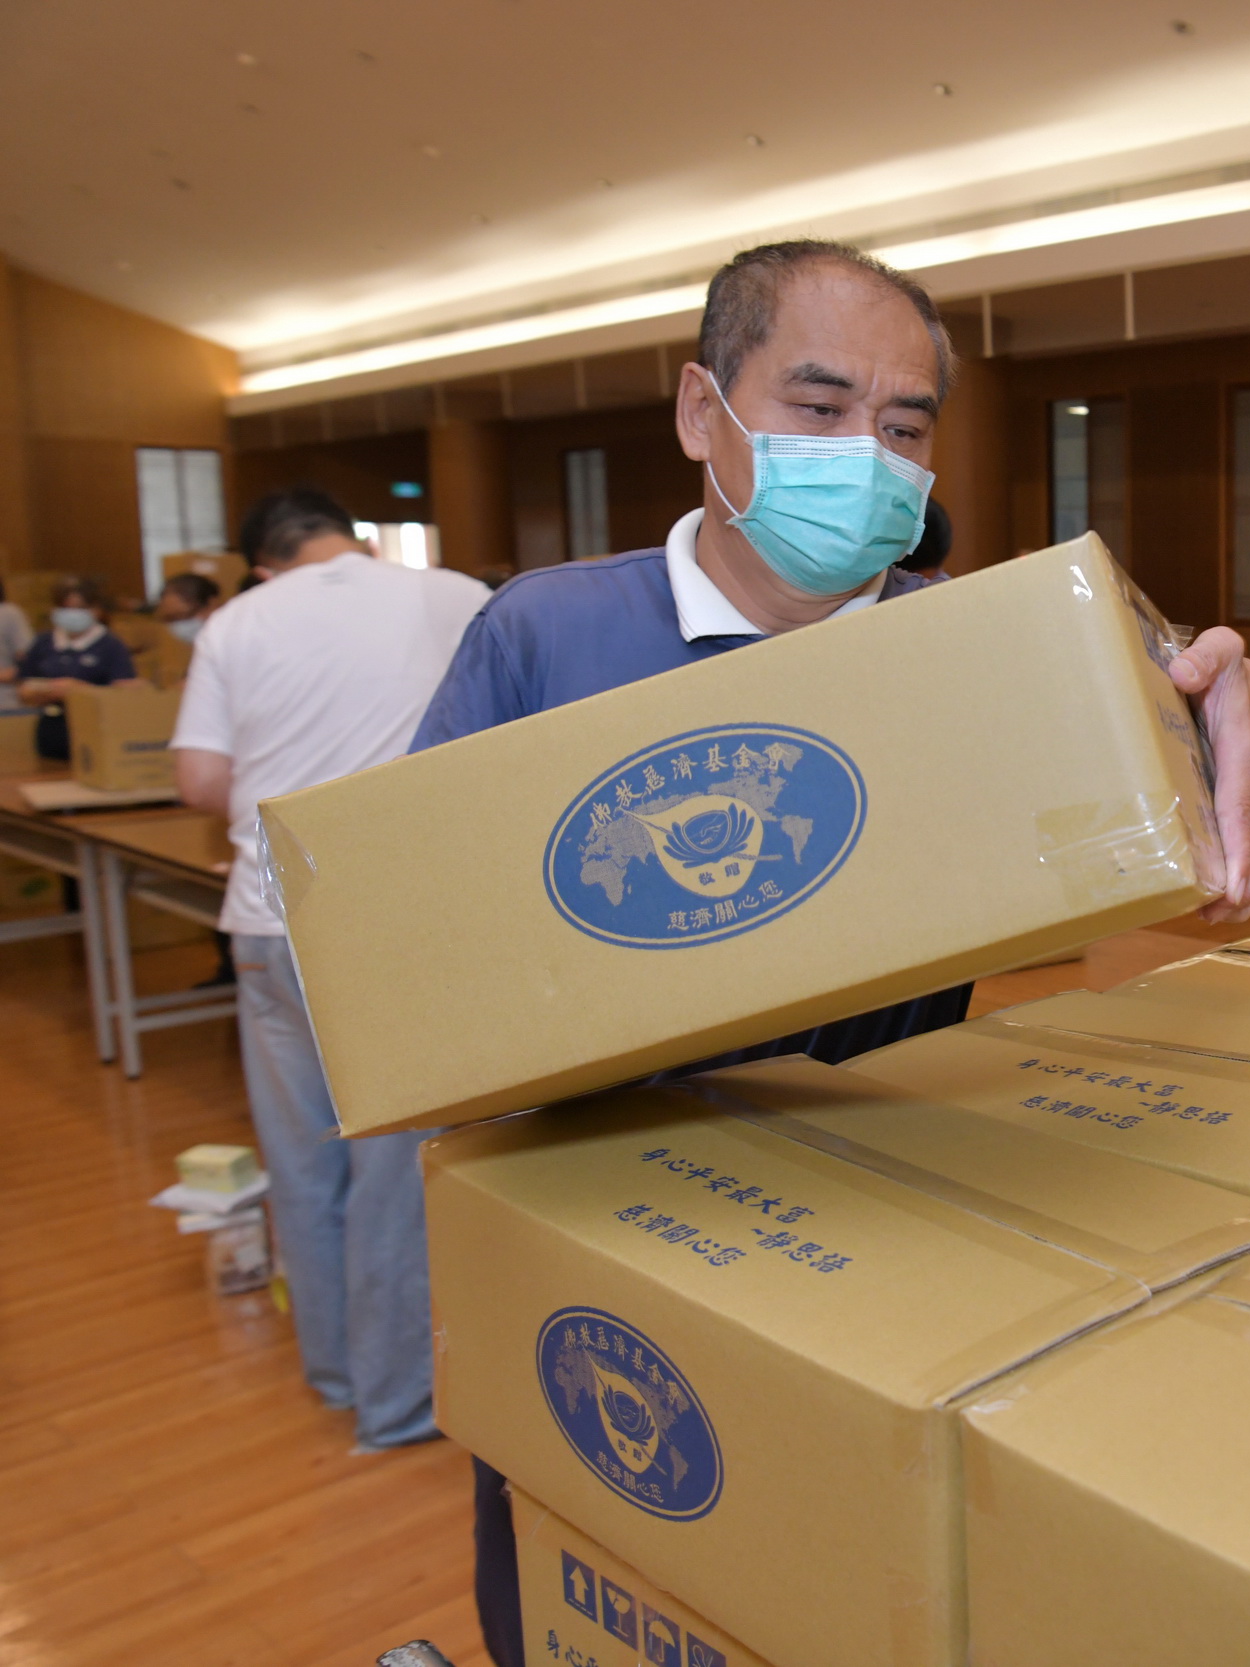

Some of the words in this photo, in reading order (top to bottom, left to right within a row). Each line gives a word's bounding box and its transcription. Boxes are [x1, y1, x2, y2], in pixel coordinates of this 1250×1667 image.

[590, 742, 791, 829] 佛教慈濟基金會
[667, 880, 783, 931] 慈濟關心您
[1016, 1059, 1184, 1097] 身心平安最大富
[1018, 1095, 1144, 1129] 慈濟關心您
[638, 1148, 815, 1224] 身心平安最大富
[613, 1204, 747, 1266] 慈濟關心您
[596, 1450, 664, 1503] 慈濟關心您
